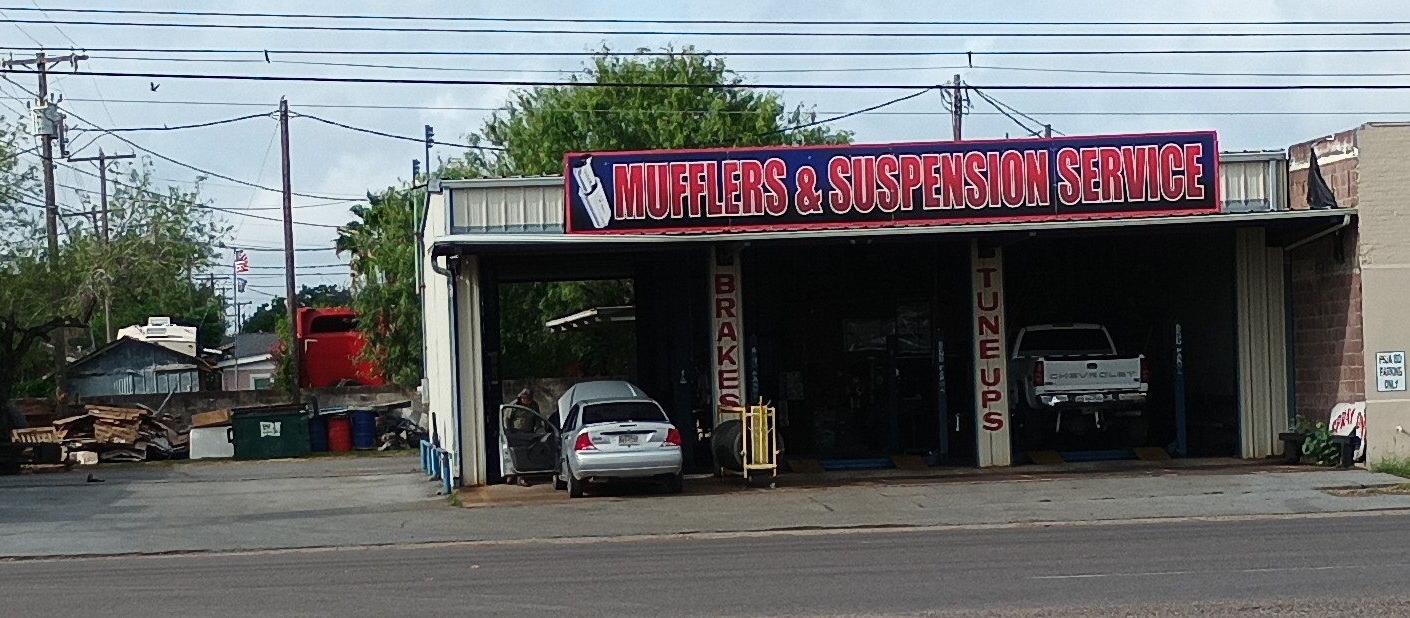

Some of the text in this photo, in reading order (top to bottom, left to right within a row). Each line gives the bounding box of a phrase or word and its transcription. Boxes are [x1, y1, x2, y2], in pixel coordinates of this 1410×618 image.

[613, 143, 1205, 220] MUFFLERS & SUSPENSION SERVICE
[715, 273, 740, 413] BRAKES
[976, 268, 1004, 431] TUNE UPS
[1050, 371, 1137, 380] CHEVROLET
